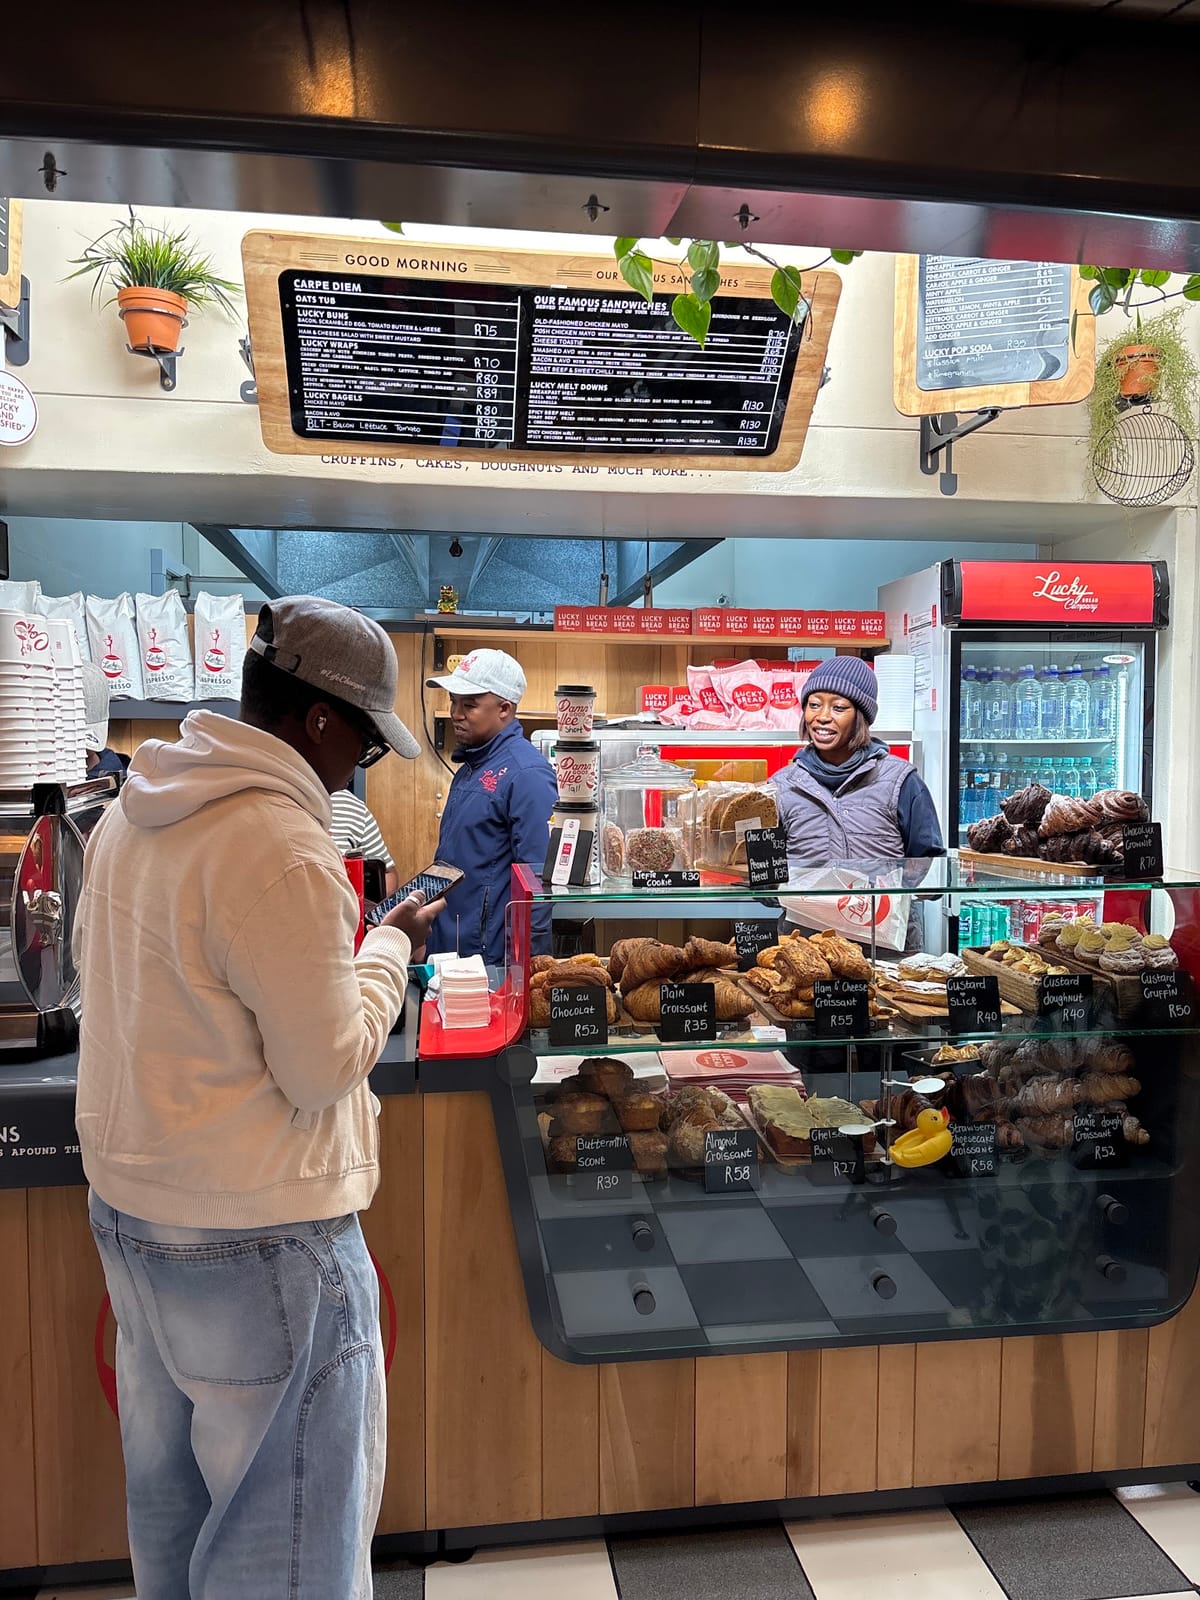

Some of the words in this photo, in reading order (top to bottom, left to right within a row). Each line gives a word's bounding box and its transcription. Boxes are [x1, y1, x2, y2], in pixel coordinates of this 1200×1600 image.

[345, 254, 390, 267] GOOD
[396, 258, 468, 273] MORNING
[293, 279, 330, 290] CARPE
[332, 281, 362, 292] DIEM
[596, 270, 618, 280] OUR
[671, 276, 739, 288] SANHES
[295, 294, 317, 303] OATS
[318, 296, 336, 305] TUB
[534, 295, 556, 305] OUR
[558, 297, 600, 308] FAMOUS
[601, 299, 668, 311] SANDWICHES
[297, 308, 325, 318] LUCKY
[327, 311, 349, 320] BUNS
[474, 322, 498, 337] R75
[584, 320, 611, 328] CHICKEN
[301, 339, 329, 348] LUCKY
[330, 341, 359, 350] WRAPS
[924, 347, 950, 357] LUCKY
[951, 346, 969, 355] POP
[970, 343, 993, 353] SODA
[474, 356, 500, 369] R70
[476, 372, 498, 384] R80
[476, 387, 497, 399] R89
[530, 381, 556, 389] LUCKY
[557, 382, 579, 390] MELT
[580, 383, 608, 392] DOWNS
[303, 391, 330, 400] LUCKY
[331, 393, 363, 402] BAGELS
[0, 402, 19, 413] UCKY
[476, 404, 498, 416] R80
[742, 399, 764, 411] R130
[477, 416, 498, 427] R95
[739, 419, 761, 430] R130
[475, 428, 495, 438] R70
[737, 436, 758, 446] R135
[481, 462, 563, 474] DOUGHNUTS
[572, 466, 599, 474] AND
[607, 467, 643, 475] MUCH
[1032, 571, 1094, 604] Lucky
[645, 693, 667, 701] LUCKY
[735, 690, 763, 698] LUCKY
[739, 696, 764, 704] BREAD
[558, 698, 588, 713] Damn
[561, 756, 592, 771] Damn
[559, 771, 582, 789] offee
[568, 783, 581, 793] Tall
[746, 831, 760, 842] Choc
[762, 828, 775, 841] Chip
[750, 858, 769, 870] Peanut
[1140, 856, 1156, 870] R70
[681, 872, 700, 881] R30
[774, 868, 788, 879] R35
[739, 944, 758, 955] Swirl
[947, 979, 986, 991] Custard
[1043, 975, 1080, 989] Custard
[1141, 972, 1176, 985] Custard
[814, 982, 832, 993] Ham
[842, 981, 868, 992] Cheese
[1043, 991, 1084, 1007] doughnut
[1063, 1008, 1085, 1021] R40
[1168, 1003, 1191, 1018] R50
[830, 1015, 853, 1028] R55
[977, 1011, 998, 1024] R40
[574, 1023, 599, 1038] R52
[684, 1020, 708, 1033] R35
[1074, 1115, 1096, 1128] Cookie
[1101, 1115, 1122, 1130] dough
[948, 1124, 996, 1135] Strawberry
[577, 1136, 629, 1151] Buttermilk
[705, 1132, 738, 1150] Almond
[64, 1145, 82, 1154] TH
[1095, 1146, 1115, 1160] R52
[833, 1161, 857, 1177] R27
[971, 1160, 994, 1172] R58
[725, 1165, 751, 1184] R58
[596, 1175, 619, 1190] R30
